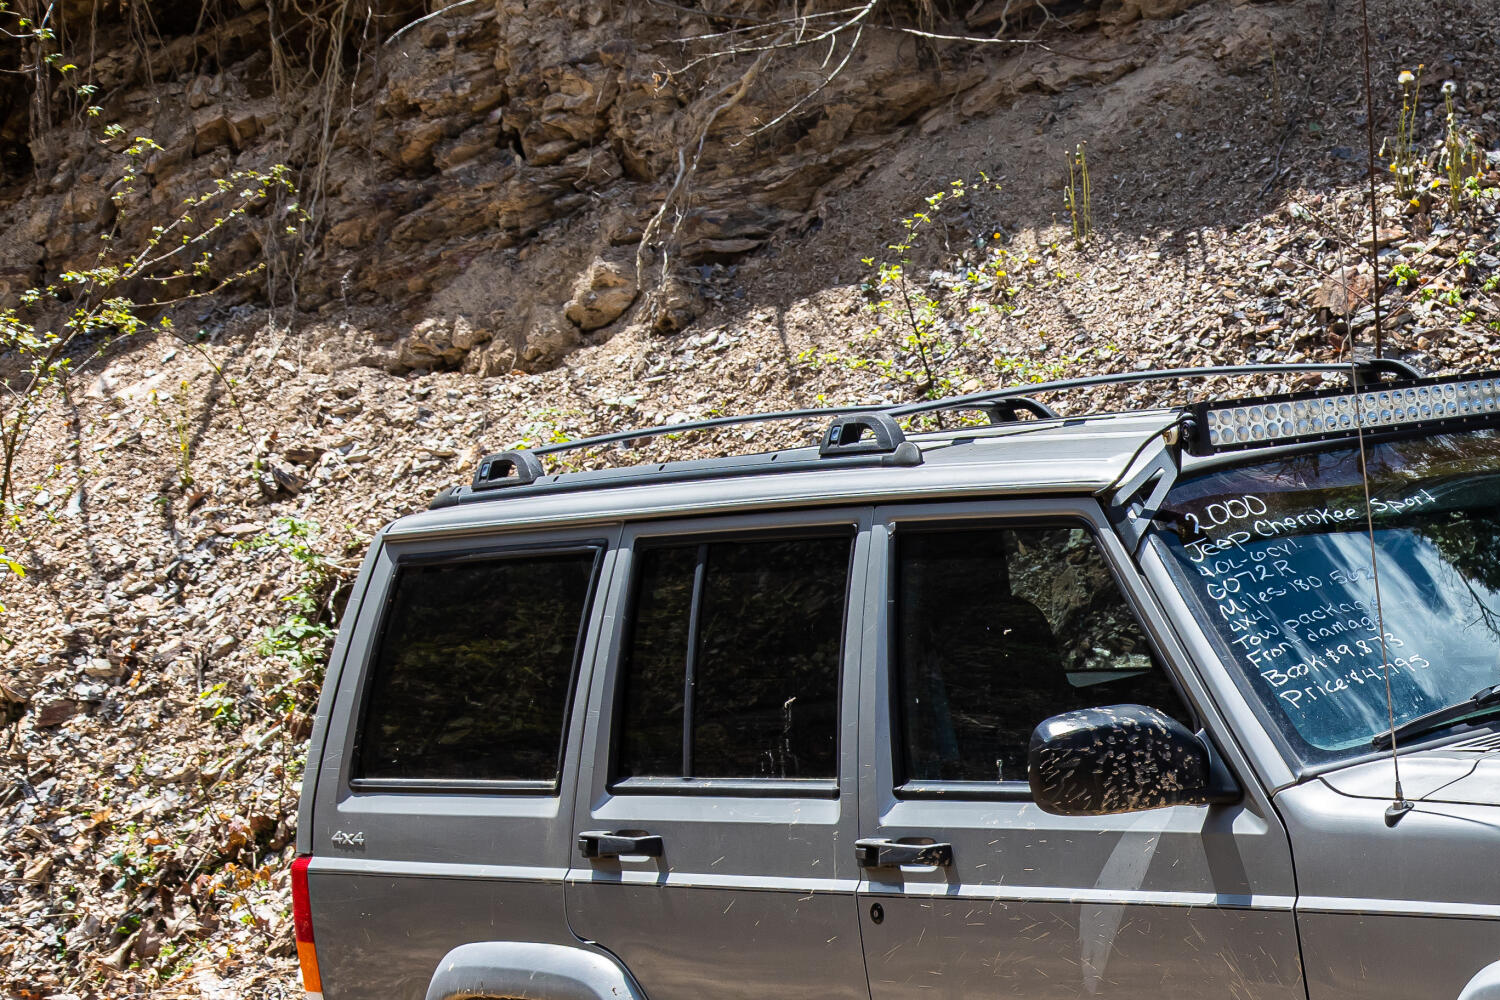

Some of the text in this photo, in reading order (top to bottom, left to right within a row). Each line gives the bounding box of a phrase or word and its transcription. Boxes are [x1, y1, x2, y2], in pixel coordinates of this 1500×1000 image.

[1184, 495, 1267, 534] 2000
[1184, 488, 1436, 562] Jeep Cherokee Sport
[1231, 624, 1280, 650] Tow
